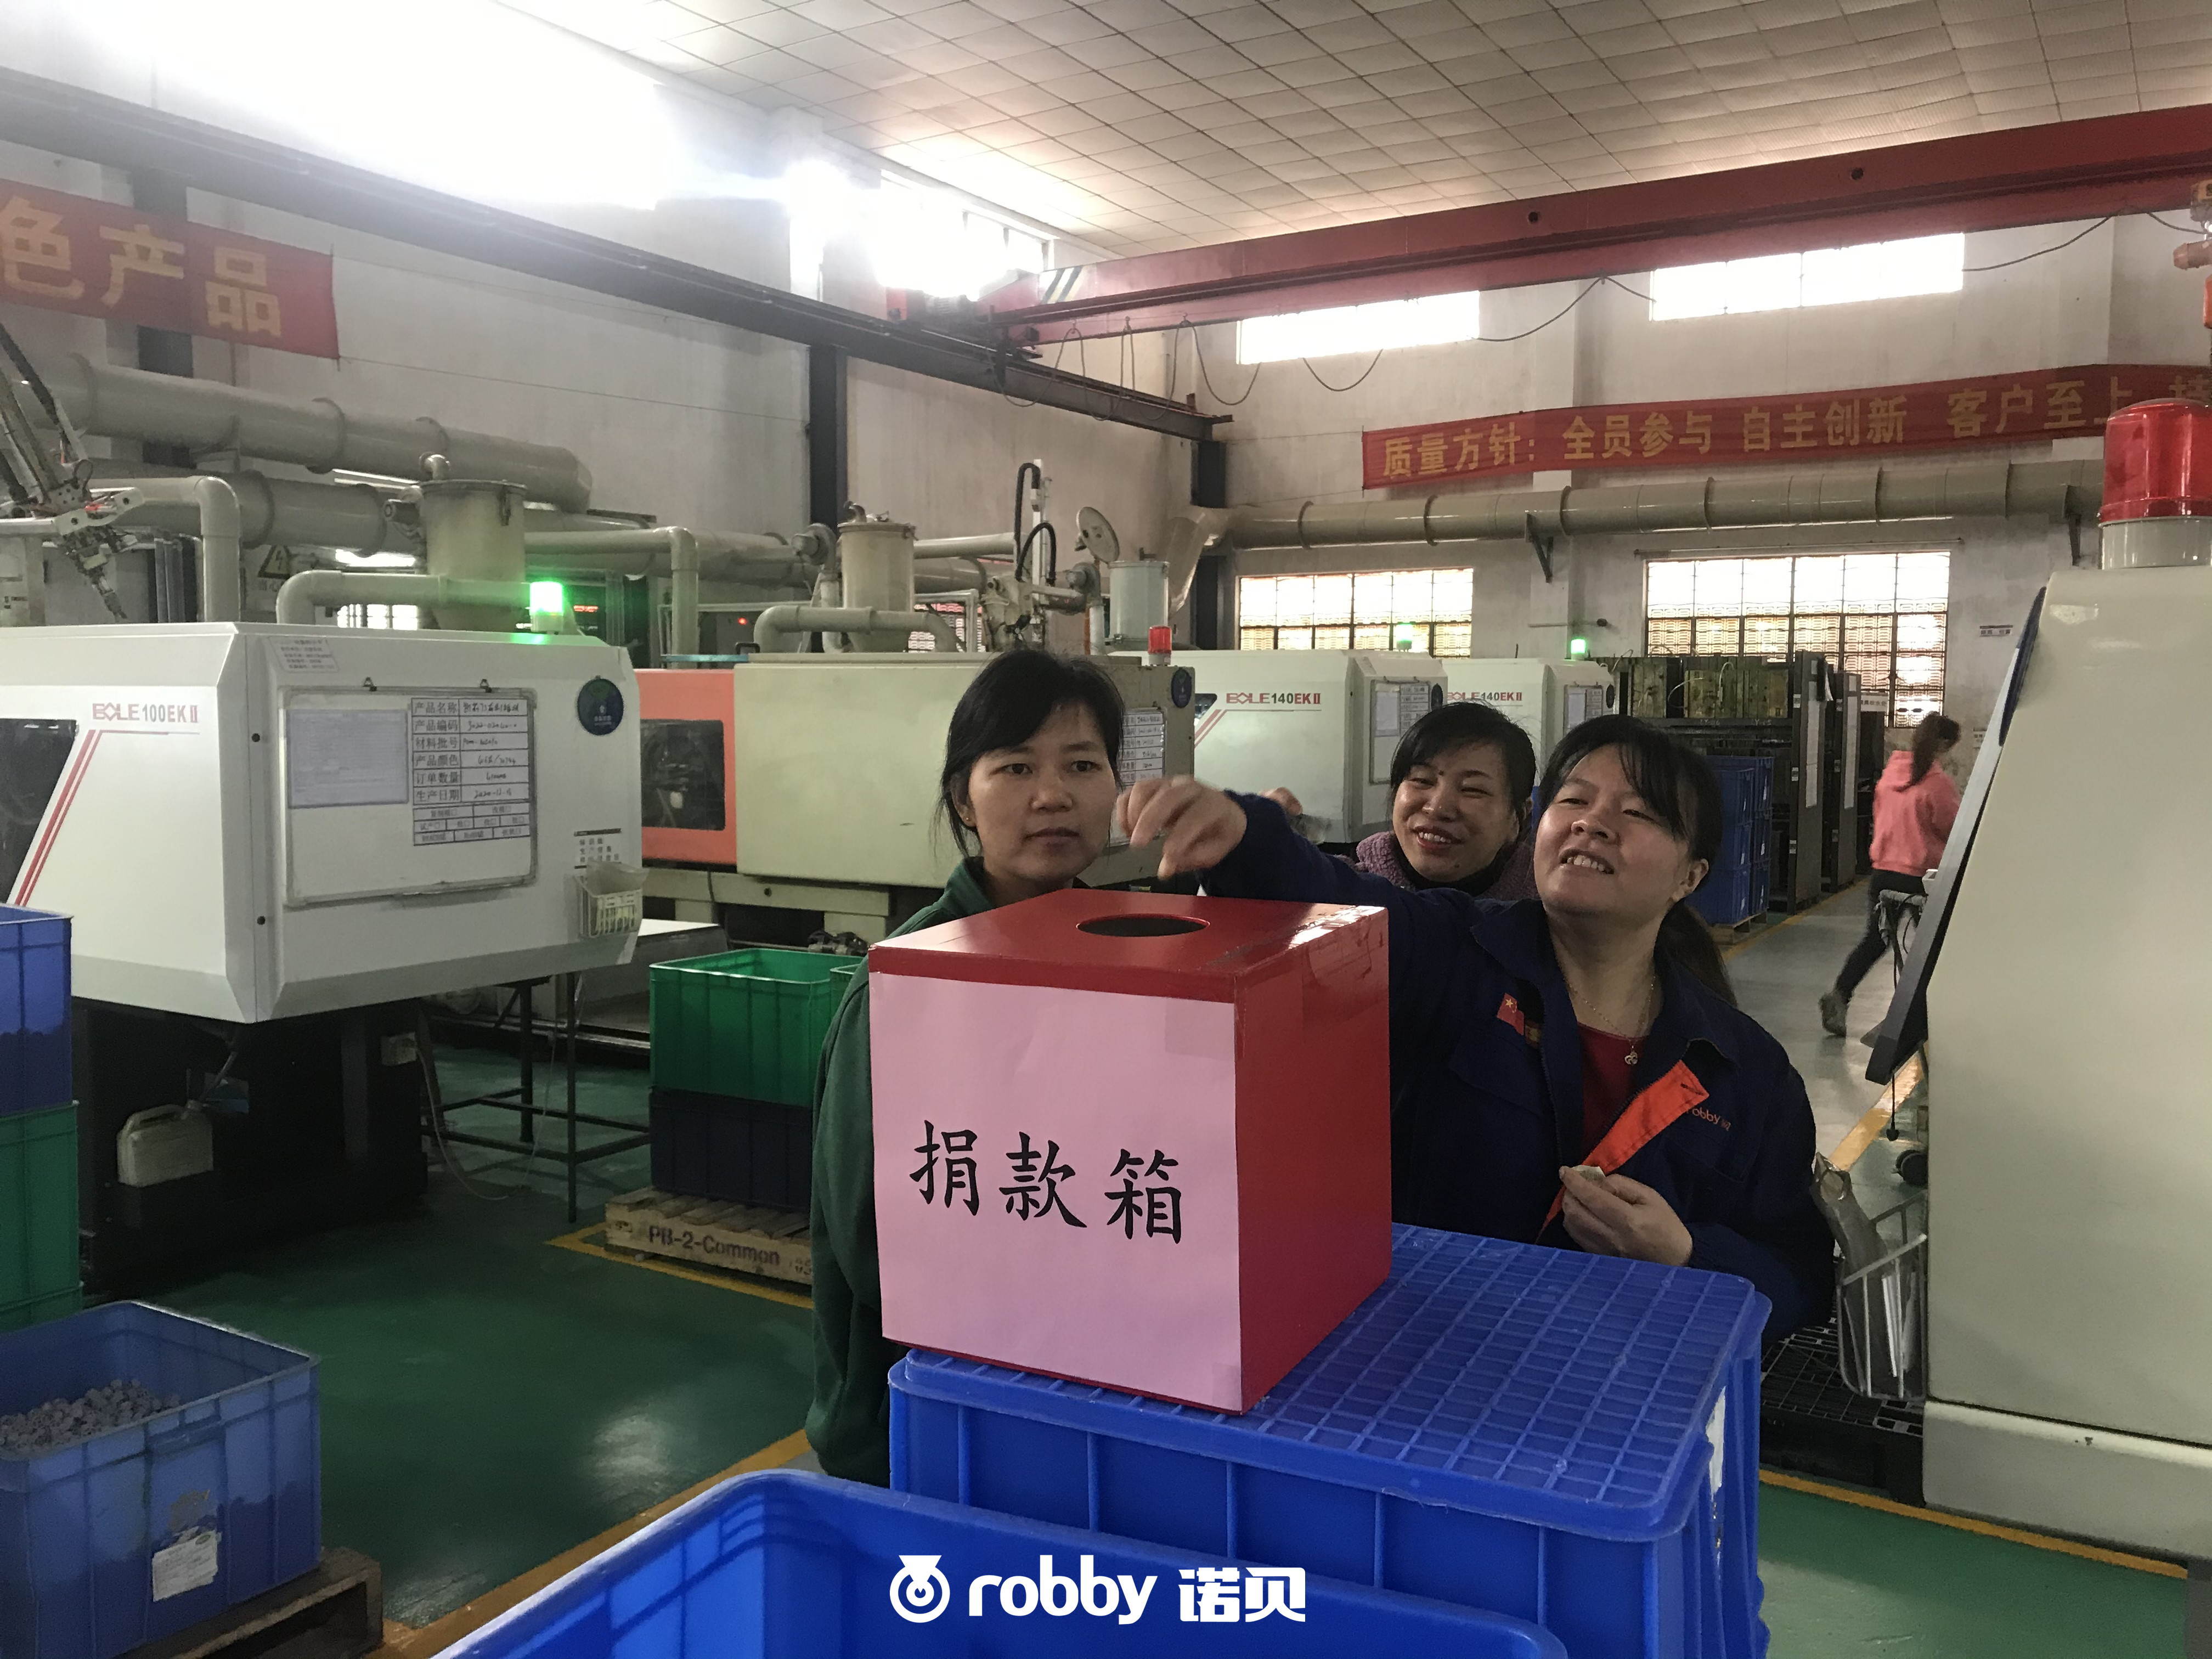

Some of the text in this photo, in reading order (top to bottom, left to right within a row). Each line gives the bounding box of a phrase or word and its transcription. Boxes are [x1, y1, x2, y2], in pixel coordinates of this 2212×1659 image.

[0, 195, 281, 337] 色产品
[1562, 410, 1713, 460] 全员参与
[1743, 394, 1908, 453] 自主创新
[1948, 376, 2132, 438] 客户至上
[416, 789, 459, 802] 生产日期
[1686, 1107, 1720, 1124] obby
[910, 1120, 1181, 1244] 捐款箱
